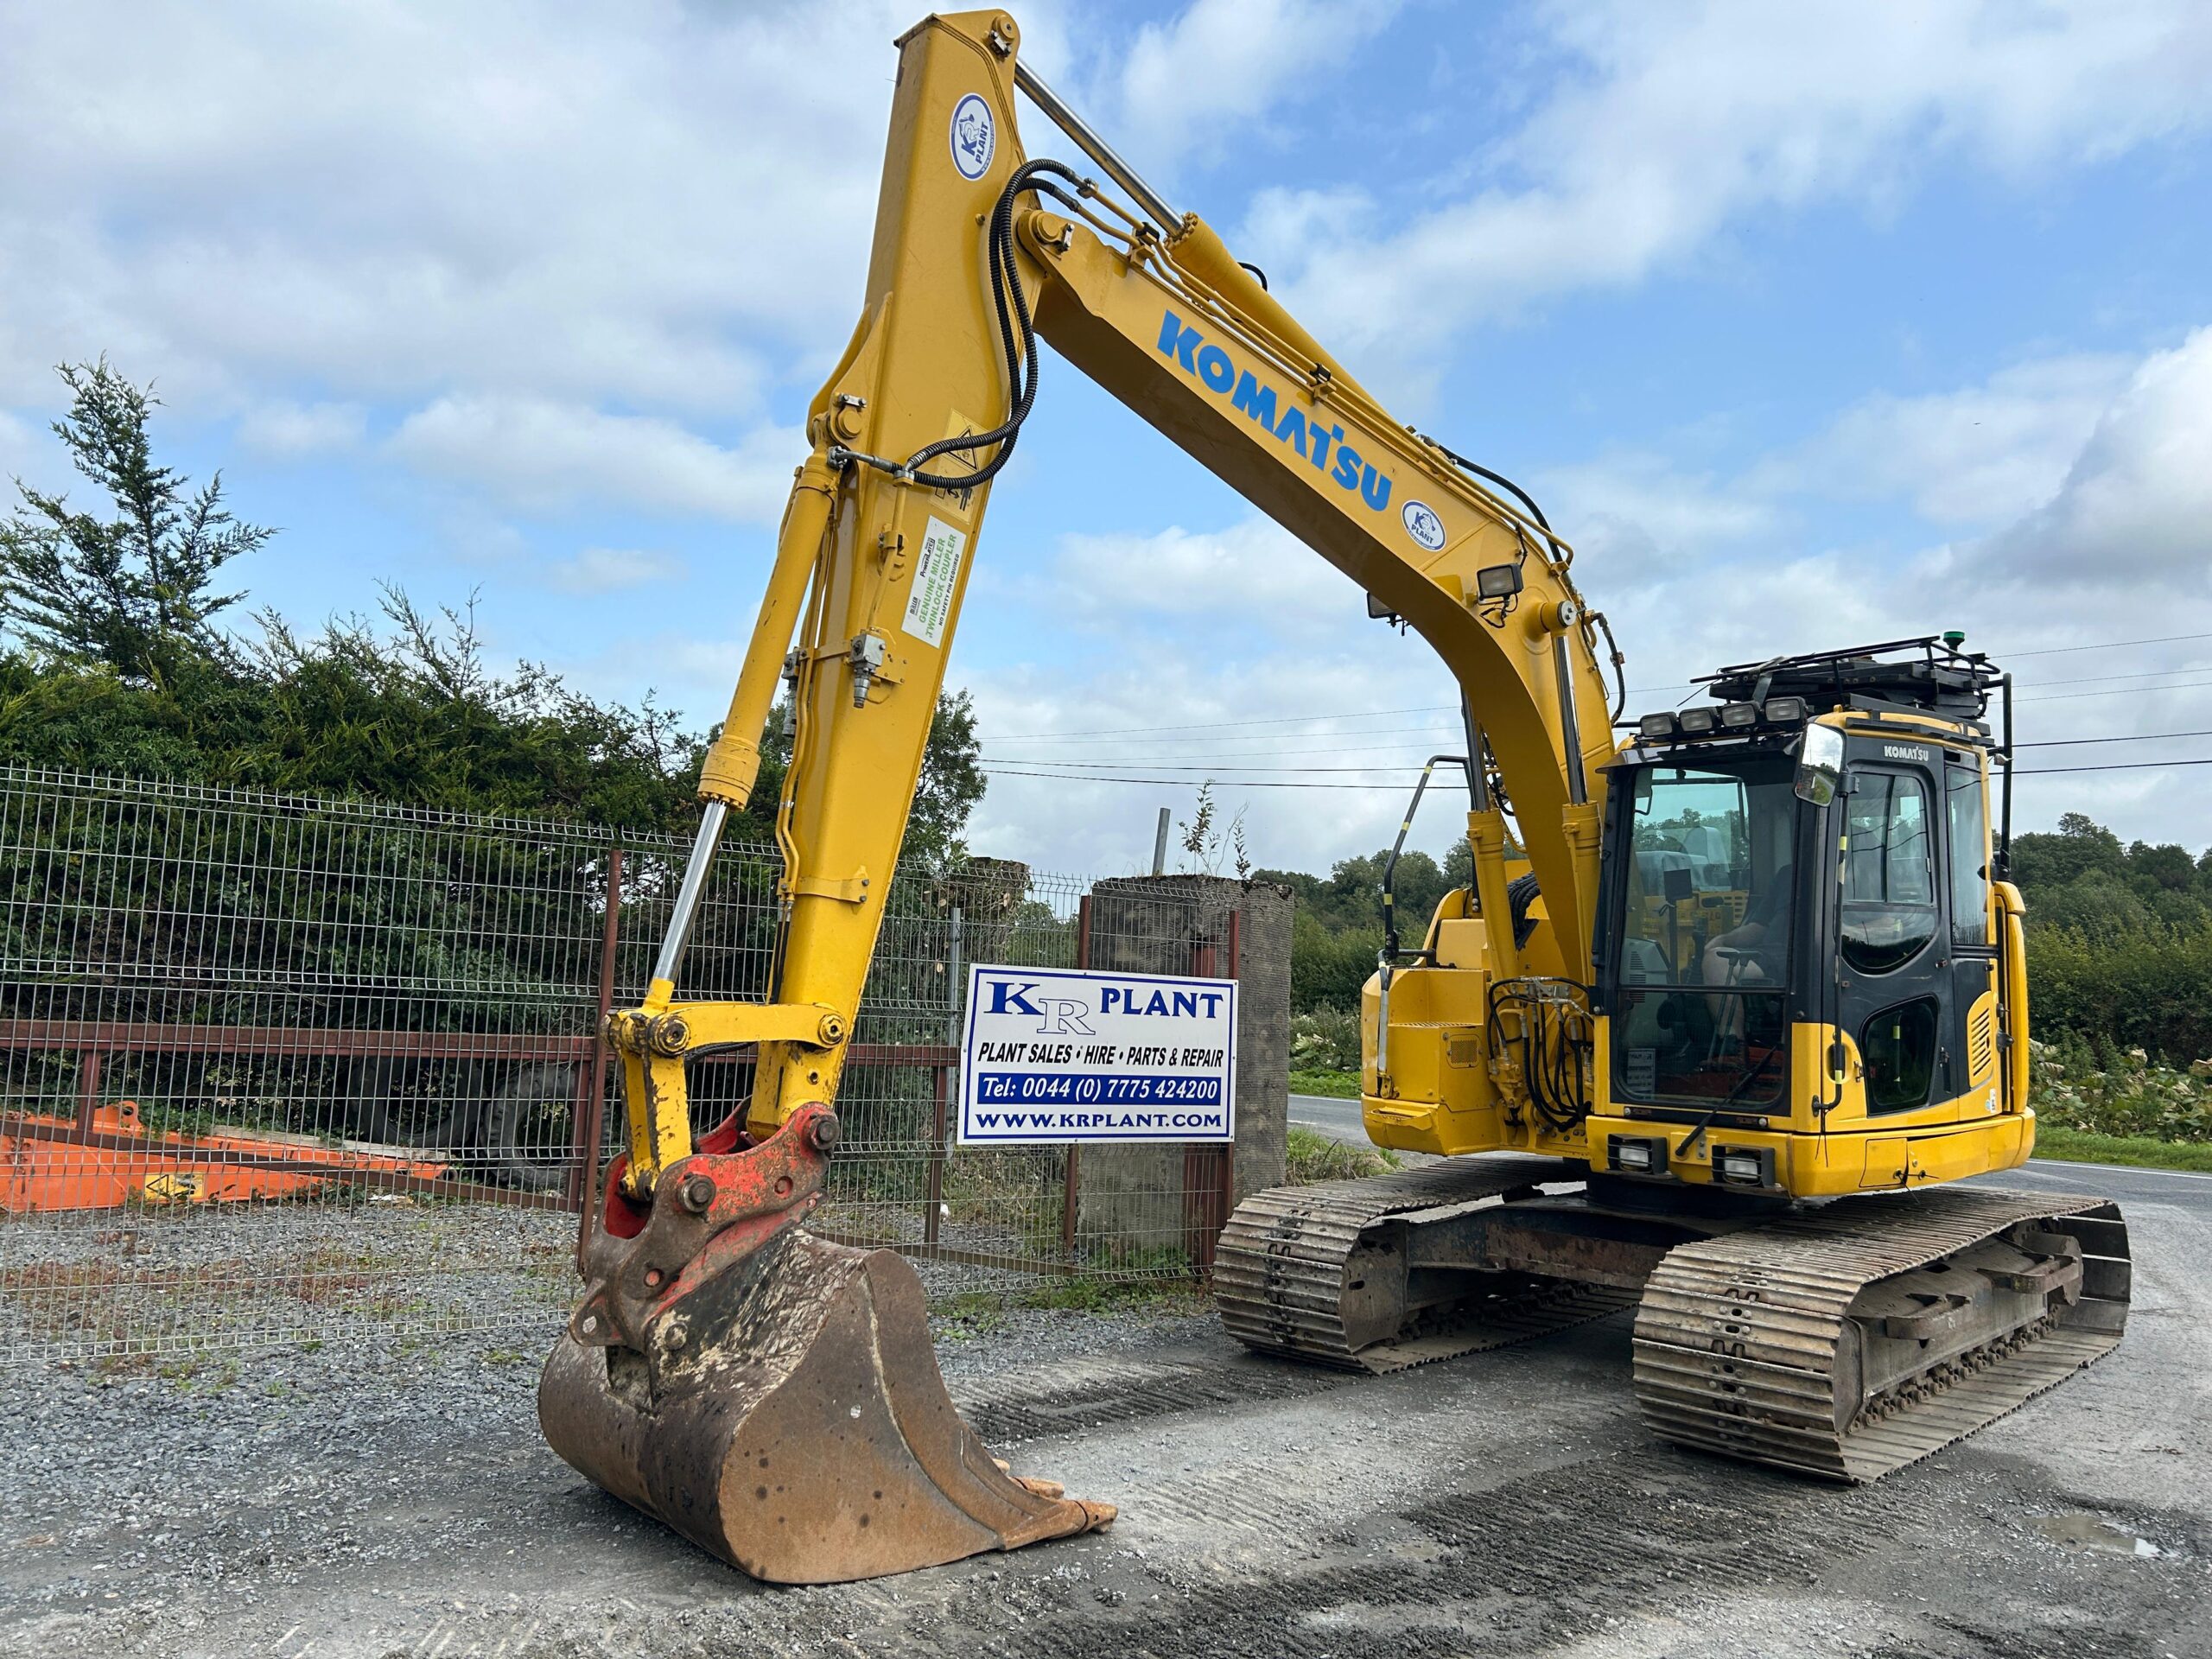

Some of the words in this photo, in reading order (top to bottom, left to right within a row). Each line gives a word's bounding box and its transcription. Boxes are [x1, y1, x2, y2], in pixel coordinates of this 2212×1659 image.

[976, 121, 988, 164] PLANT
[1157, 309, 1392, 512] KOMATSU
[1411, 524, 1433, 544] PLANT
[918, 577, 936, 624] GENUINE
[931, 537, 946, 576] MILLER
[925, 582, 945, 638] TWINLOCK
[940, 533, 957, 582] COUPLER
[938, 616, 944, 626] NO
[941, 594, 950, 617] SAFETY
[950, 553, 960, 582] REQUIRED
[1884, 746, 1929, 761] KOMATSU
[1100, 987, 1224, 1019] PLANT
[977, 1042, 1027, 1063] PLANT
[1028, 1044, 1072, 1064] SALES
[1084, 1046, 1116, 1065] HIRE
[1126, 1046, 1166, 1066] PARTS
[1168, 1049, 1178, 1066] &
[1180, 1049, 1224, 1067] REPAIR
[983, 1077, 1016, 1097] Tel:
[1022, 1077, 1071, 1097] 0044
[1076, 1077, 1102, 1103] (0)
[1108, 1079, 1150, 1098] 7775
[1154, 1080, 1217, 1099] 424200
[975, 1113, 1222, 1128] WWW.KRPLANT.COM
